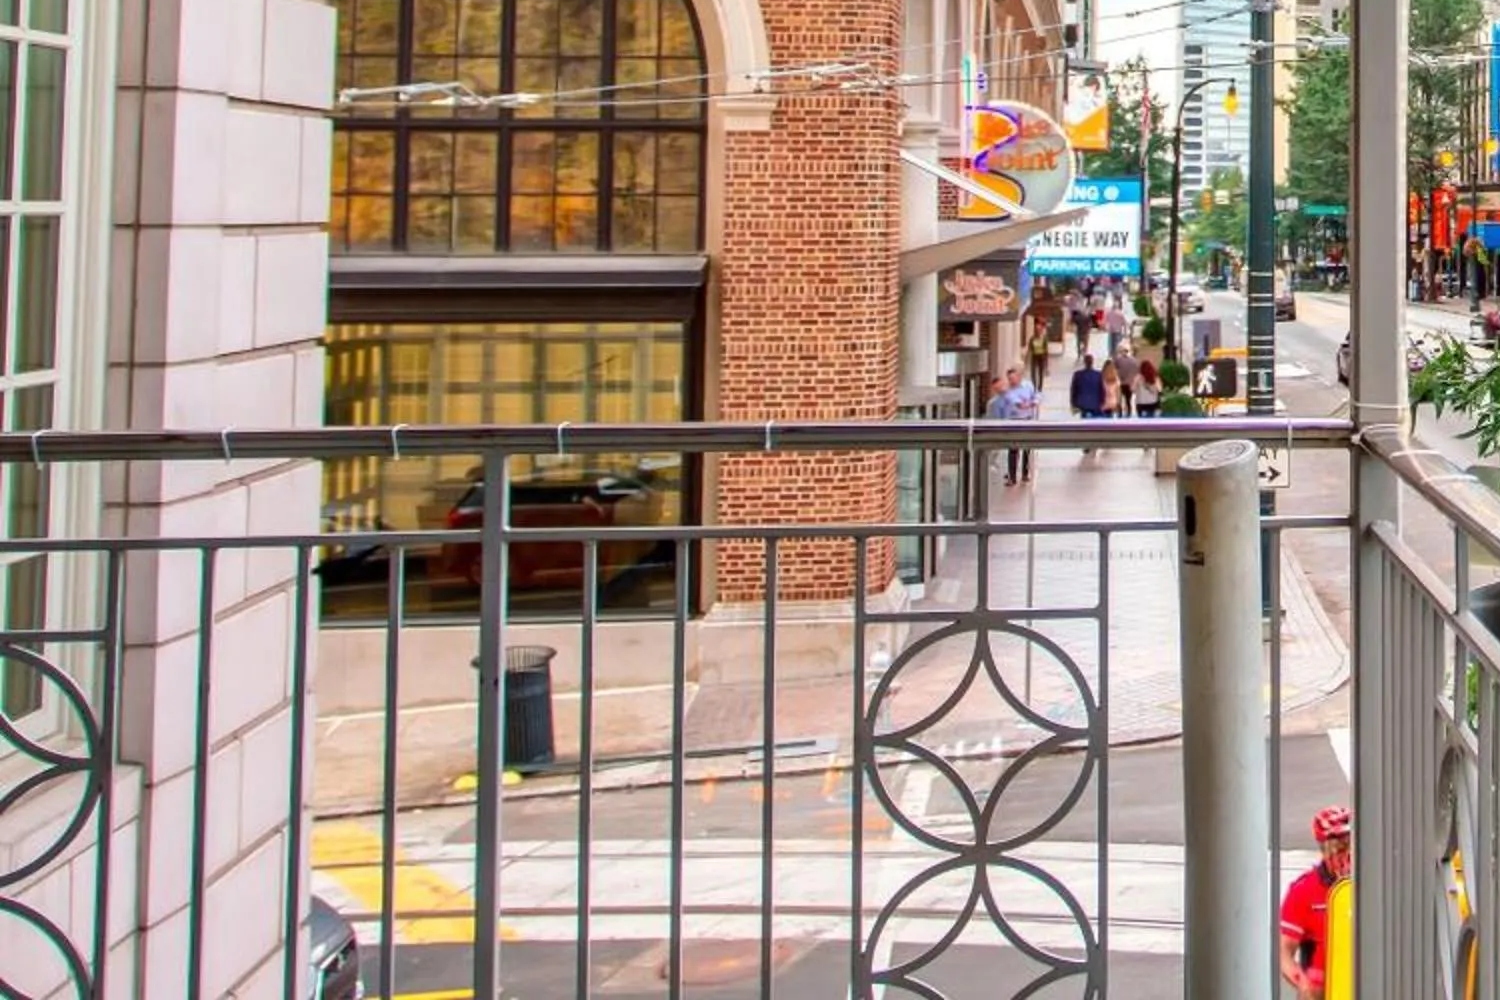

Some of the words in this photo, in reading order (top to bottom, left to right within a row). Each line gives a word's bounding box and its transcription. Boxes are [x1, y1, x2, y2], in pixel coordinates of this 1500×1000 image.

[1093, 231, 1130, 248] WAY
[1034, 260, 1091, 272] PARKING
[1094, 260, 1130, 271] DECK
